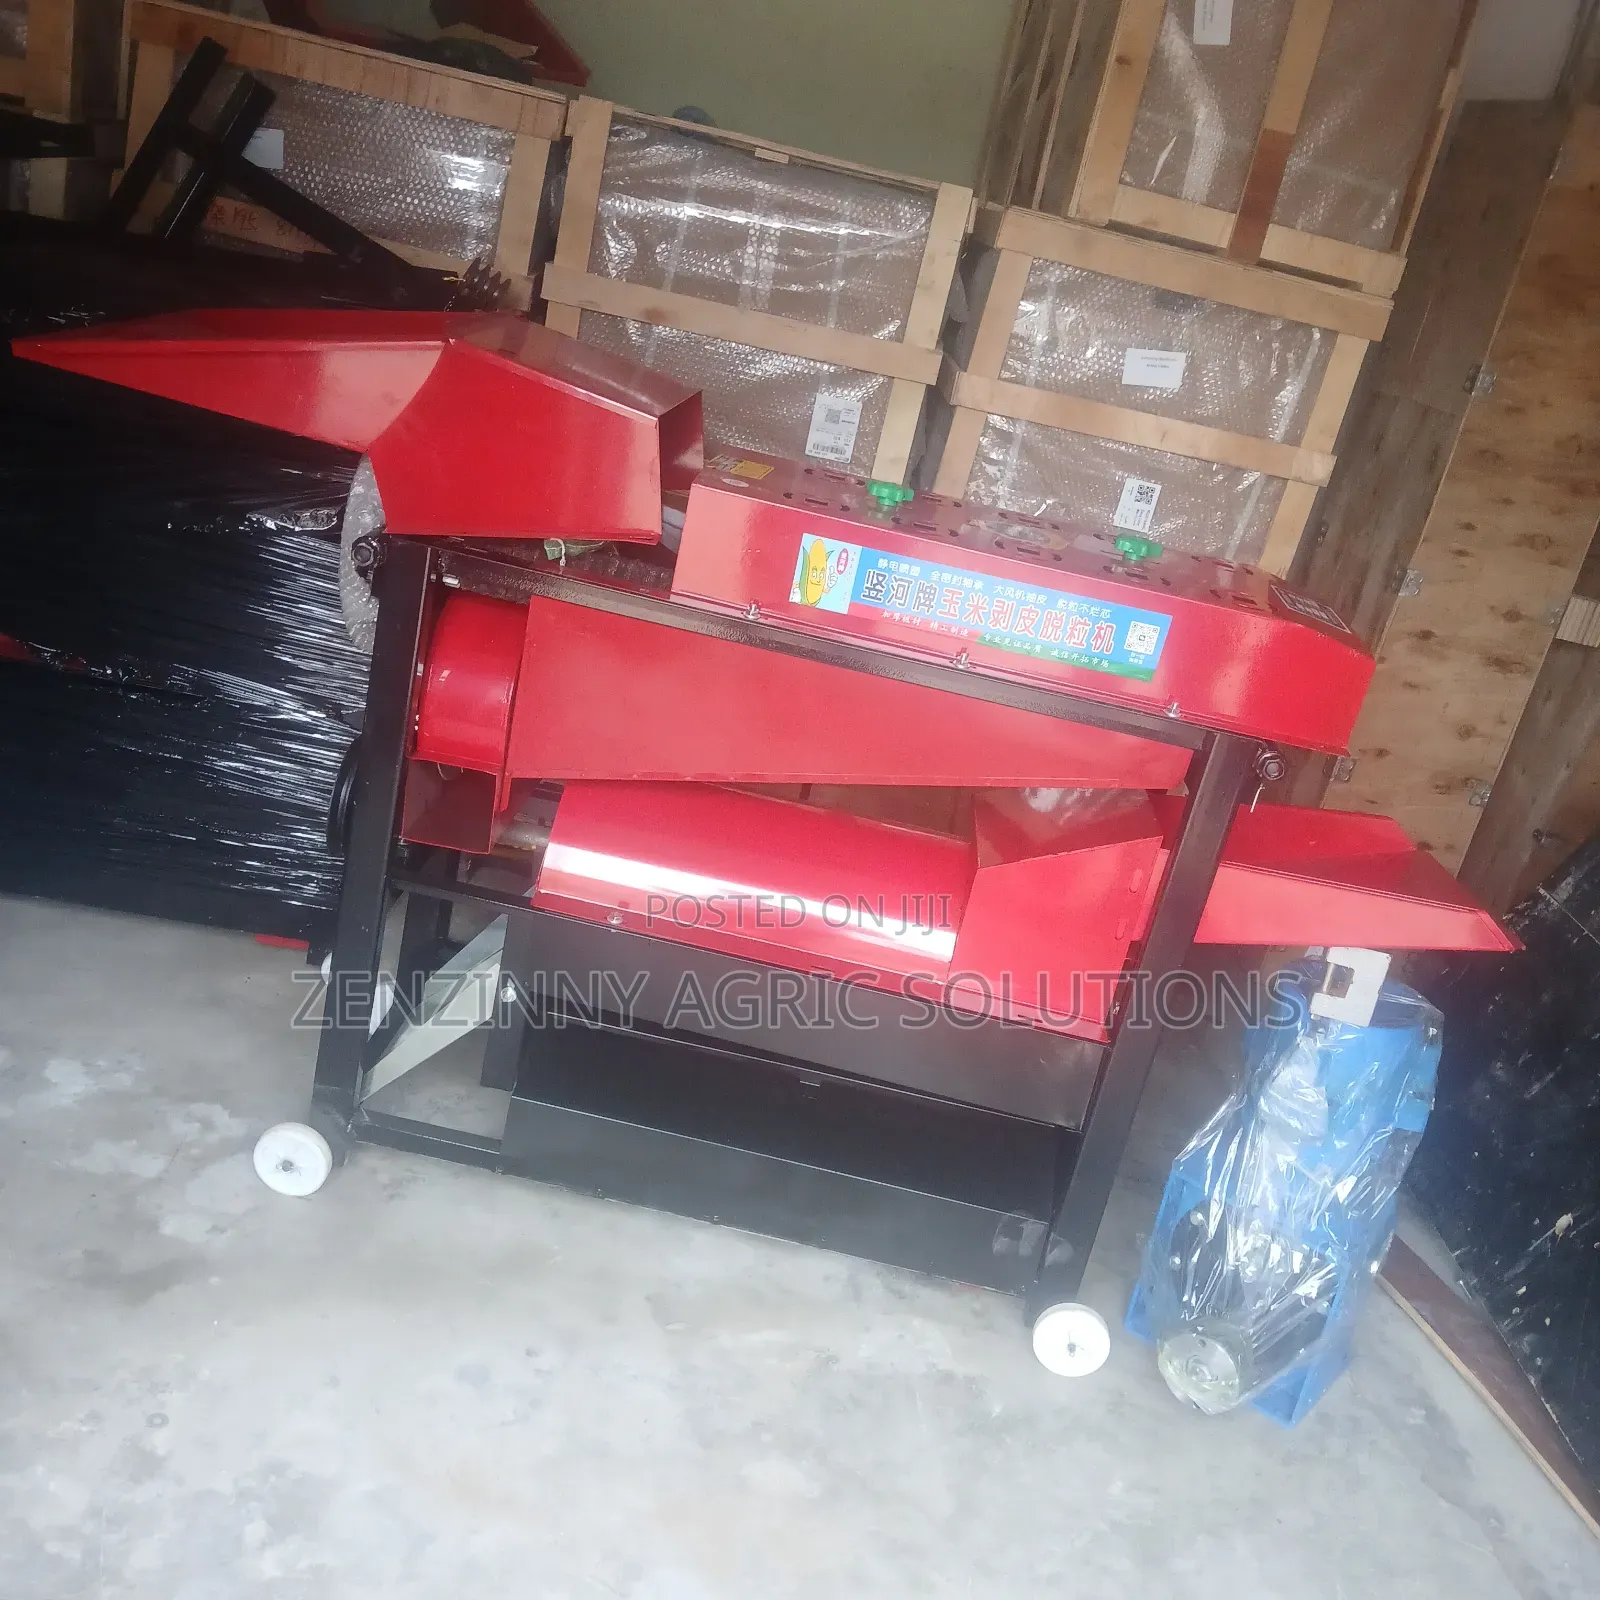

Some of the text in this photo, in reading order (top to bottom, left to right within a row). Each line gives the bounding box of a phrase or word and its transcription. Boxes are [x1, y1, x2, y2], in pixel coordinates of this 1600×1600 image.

[861, 569, 1116, 654] 竖河牌玉米剥皮脱粒机
